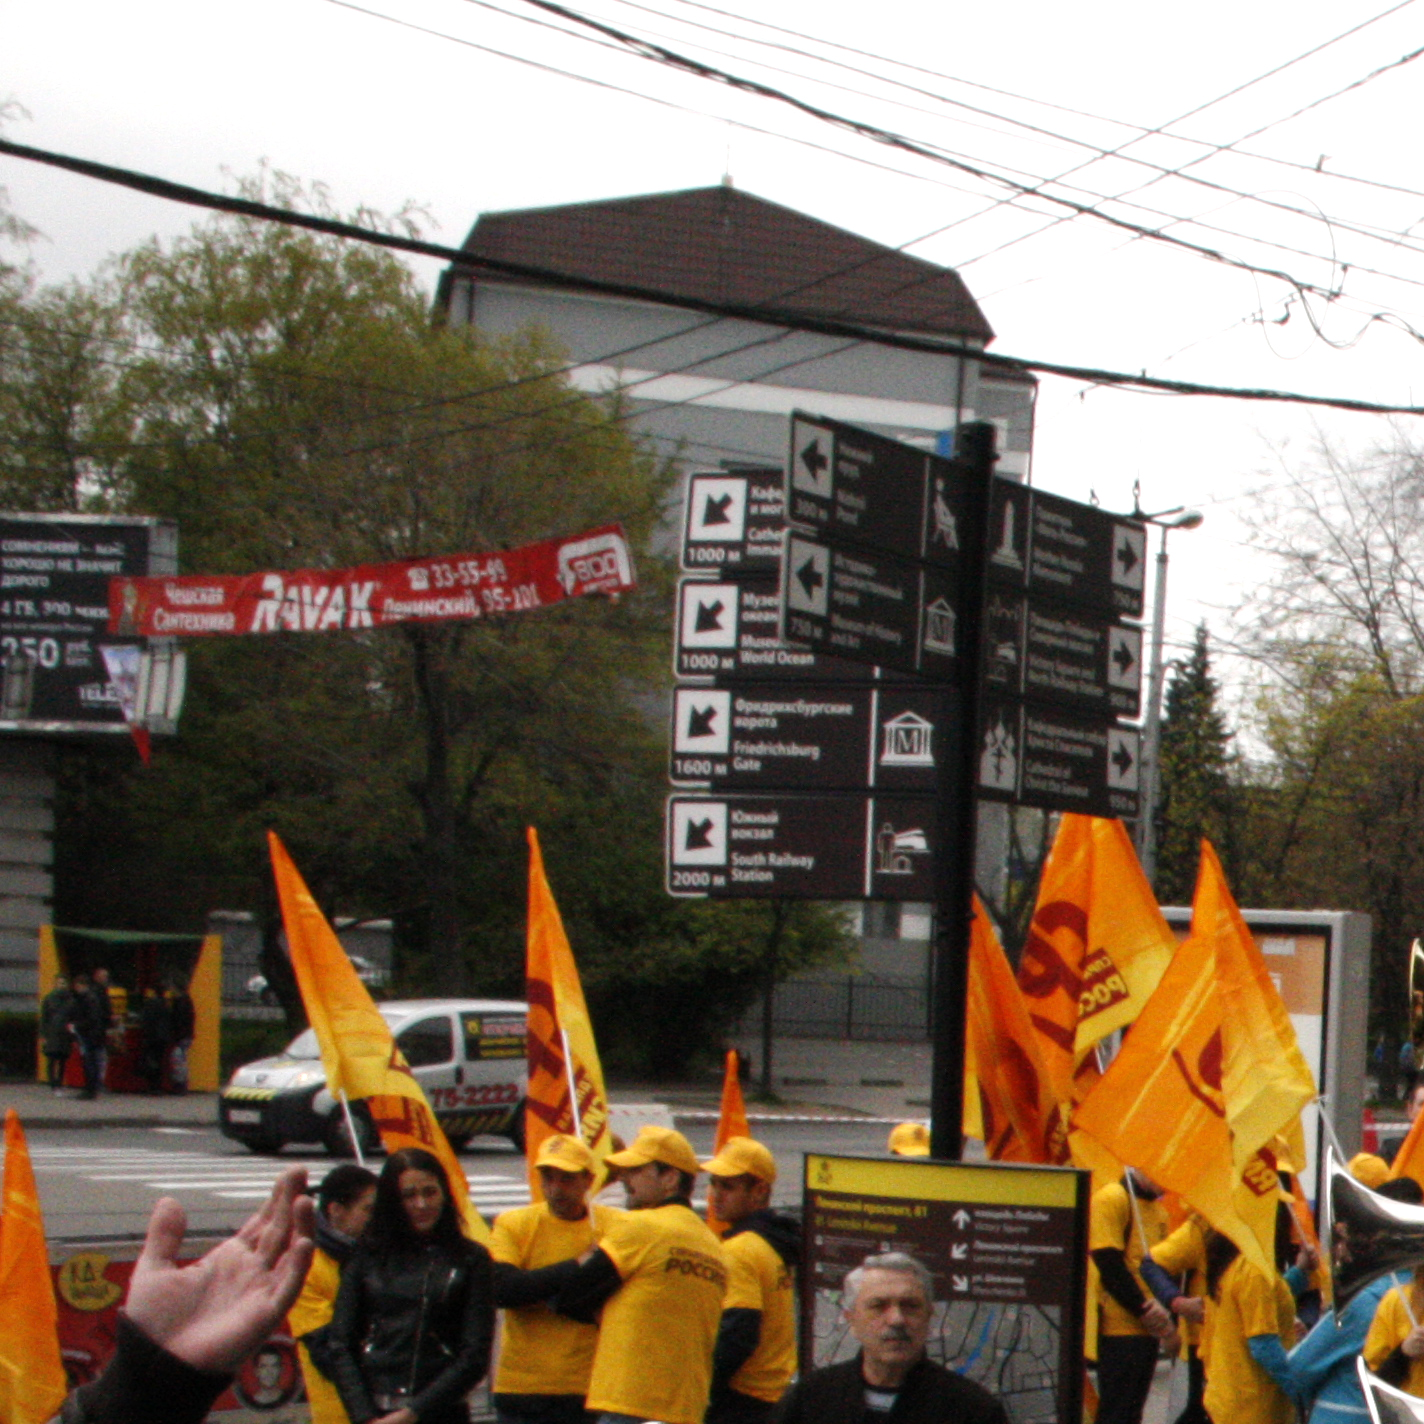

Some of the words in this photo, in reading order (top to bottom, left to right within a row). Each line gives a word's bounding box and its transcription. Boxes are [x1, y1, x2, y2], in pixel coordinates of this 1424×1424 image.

[689, 548, 725, 562] 1000
[727, 551, 740, 562] м
[682, 653, 718, 668] 1000
[721, 659, 735, 669] м
[740, 651, 775, 665] World
[777, 652, 815, 665] Ocean
[733, 716, 778, 730] ворота
[733, 741, 821, 760] Friedrichsburg
[673, 760, 711, 775] 1600
[714, 764, 728, 775] м
[733, 757, 762, 772] Gate
[731, 809, 779, 824] Южный
[731, 827, 774, 839] вокзал
[731, 852, 766, 867] South
[768, 854, 815, 870] Railway
[673, 872, 710, 887] 2000
[713, 875, 726, 887] м
[731, 868, 774, 882] Station
